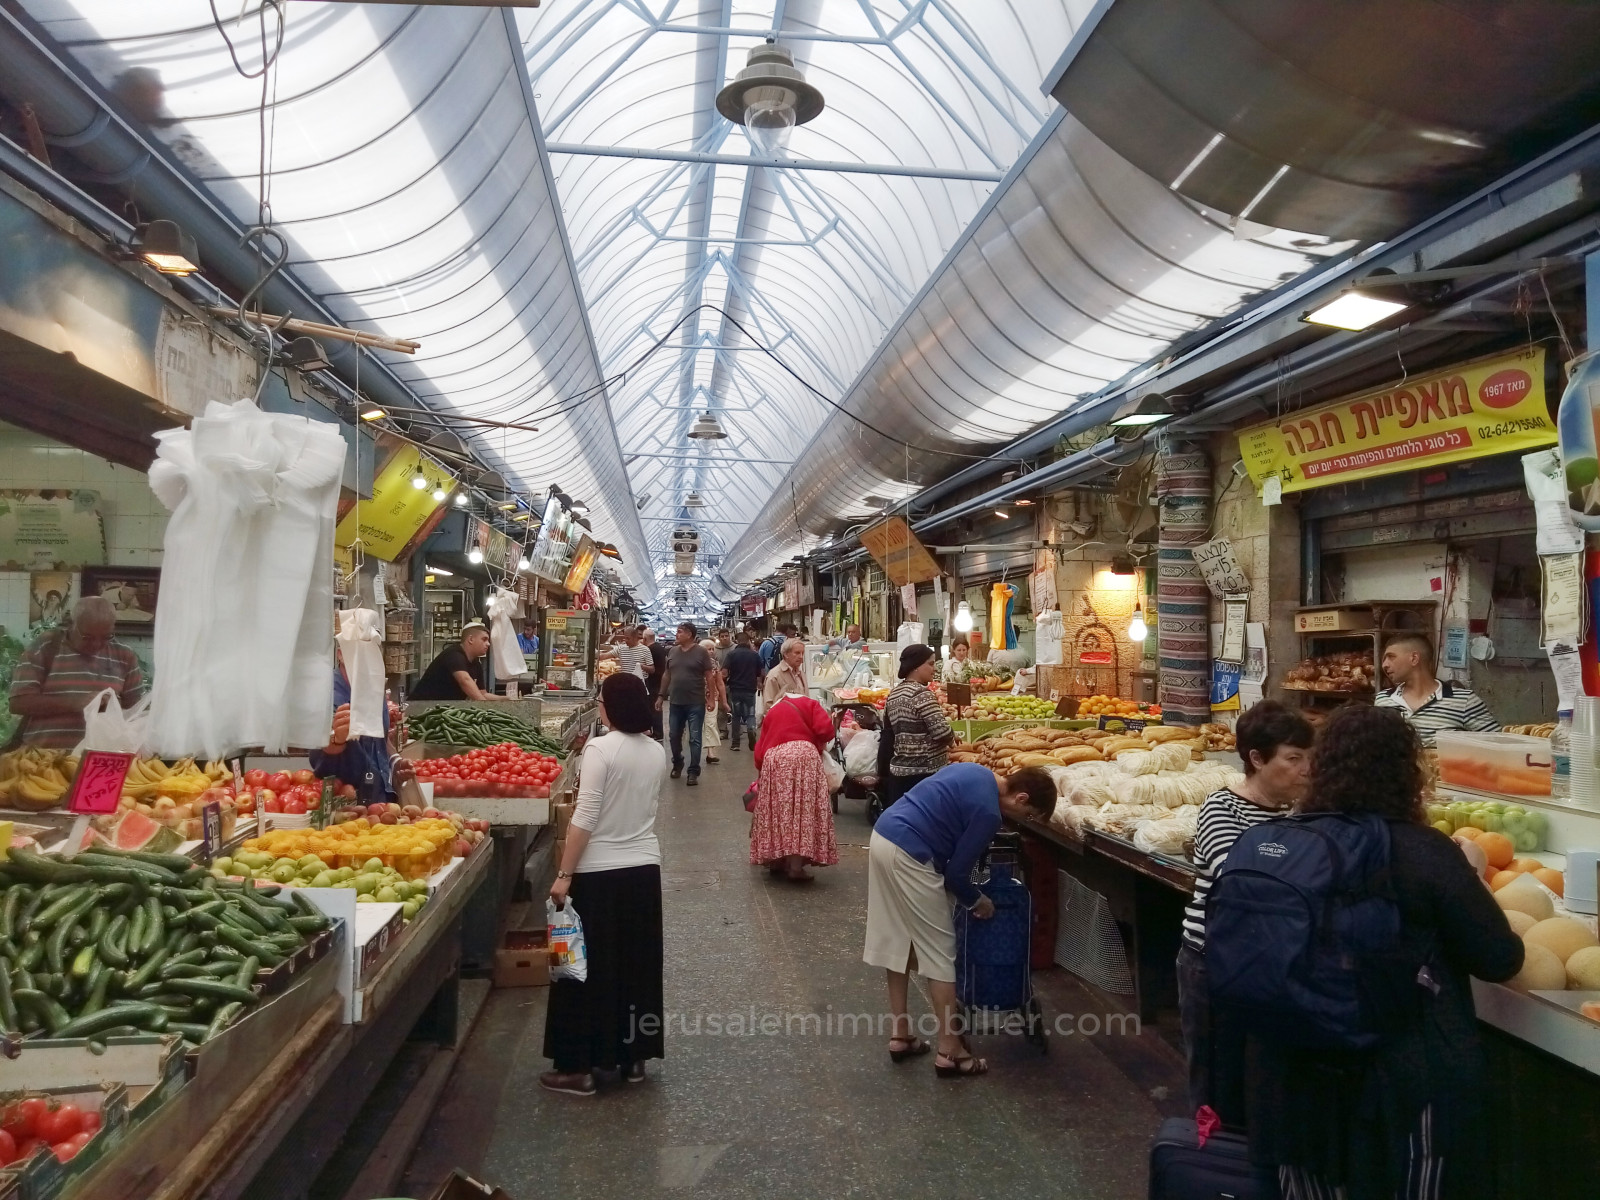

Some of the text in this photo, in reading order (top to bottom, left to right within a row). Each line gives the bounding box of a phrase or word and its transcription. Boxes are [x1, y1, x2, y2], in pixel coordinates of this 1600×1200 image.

[1484, 379, 1526, 398] מאז 1967
[1281, 375, 1474, 456] מאפיית חבה
[1308, 432, 1461, 474] כל סוגי הלחמים והפיתות טרי יום יום
